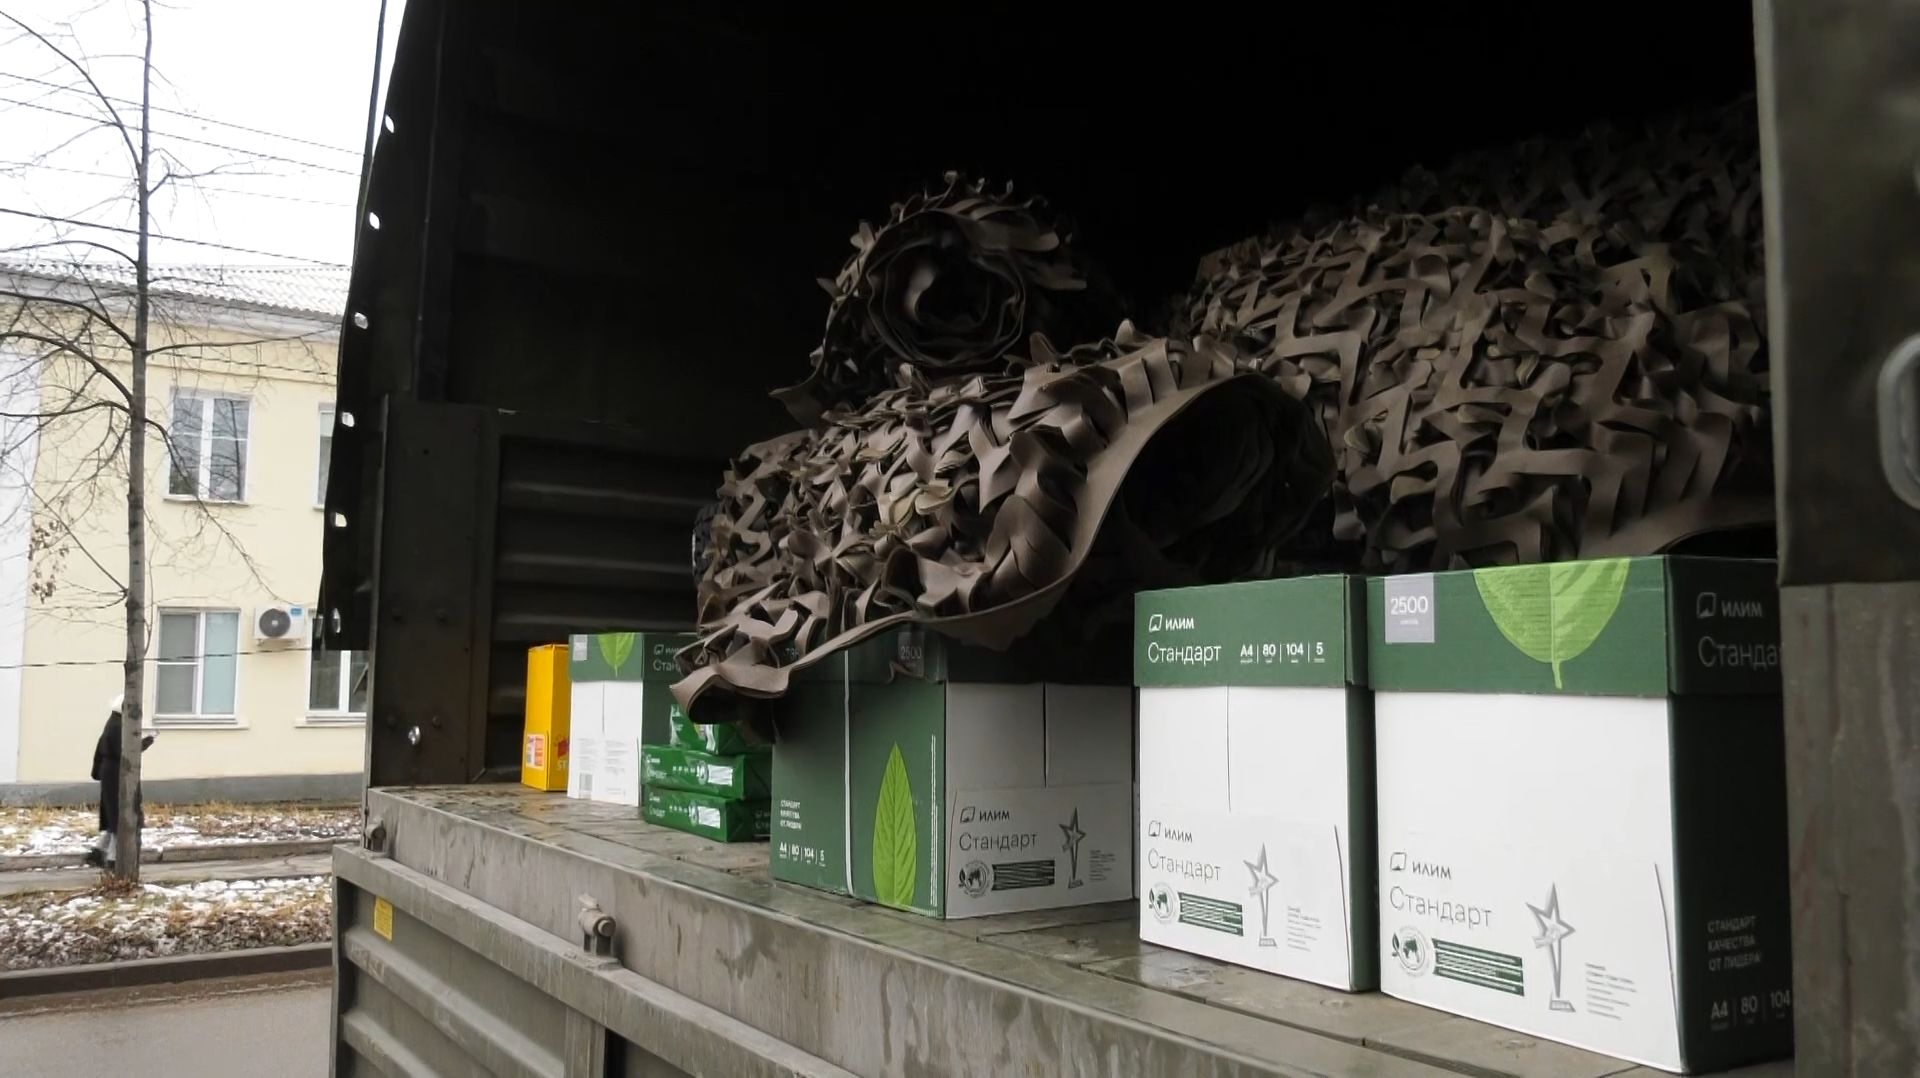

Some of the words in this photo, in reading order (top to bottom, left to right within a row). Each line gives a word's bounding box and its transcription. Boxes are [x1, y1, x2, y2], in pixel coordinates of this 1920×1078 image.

[1390, 596, 1429, 615] 2500
[1148, 642, 1221, 667] Стандарт
[1262, 643, 1276, 657] 80
[1286, 642, 1304, 656] 104
[1315, 642, 1324, 656] 5
[959, 832, 1038, 852] Стандарт
[804, 847, 814, 859] 104
[1148, 848, 1221, 883] Стандарт
[1389, 886, 1493, 929] Стандарт
[1707, 915, 1757, 934] СТАНДАРТ
[1707, 934, 1756, 952] КАЧЕСТВА
[1708, 957, 1721, 972] ОТ
[1741, 995, 1758, 1015] 80
[1770, 989, 1792, 1009] 104
